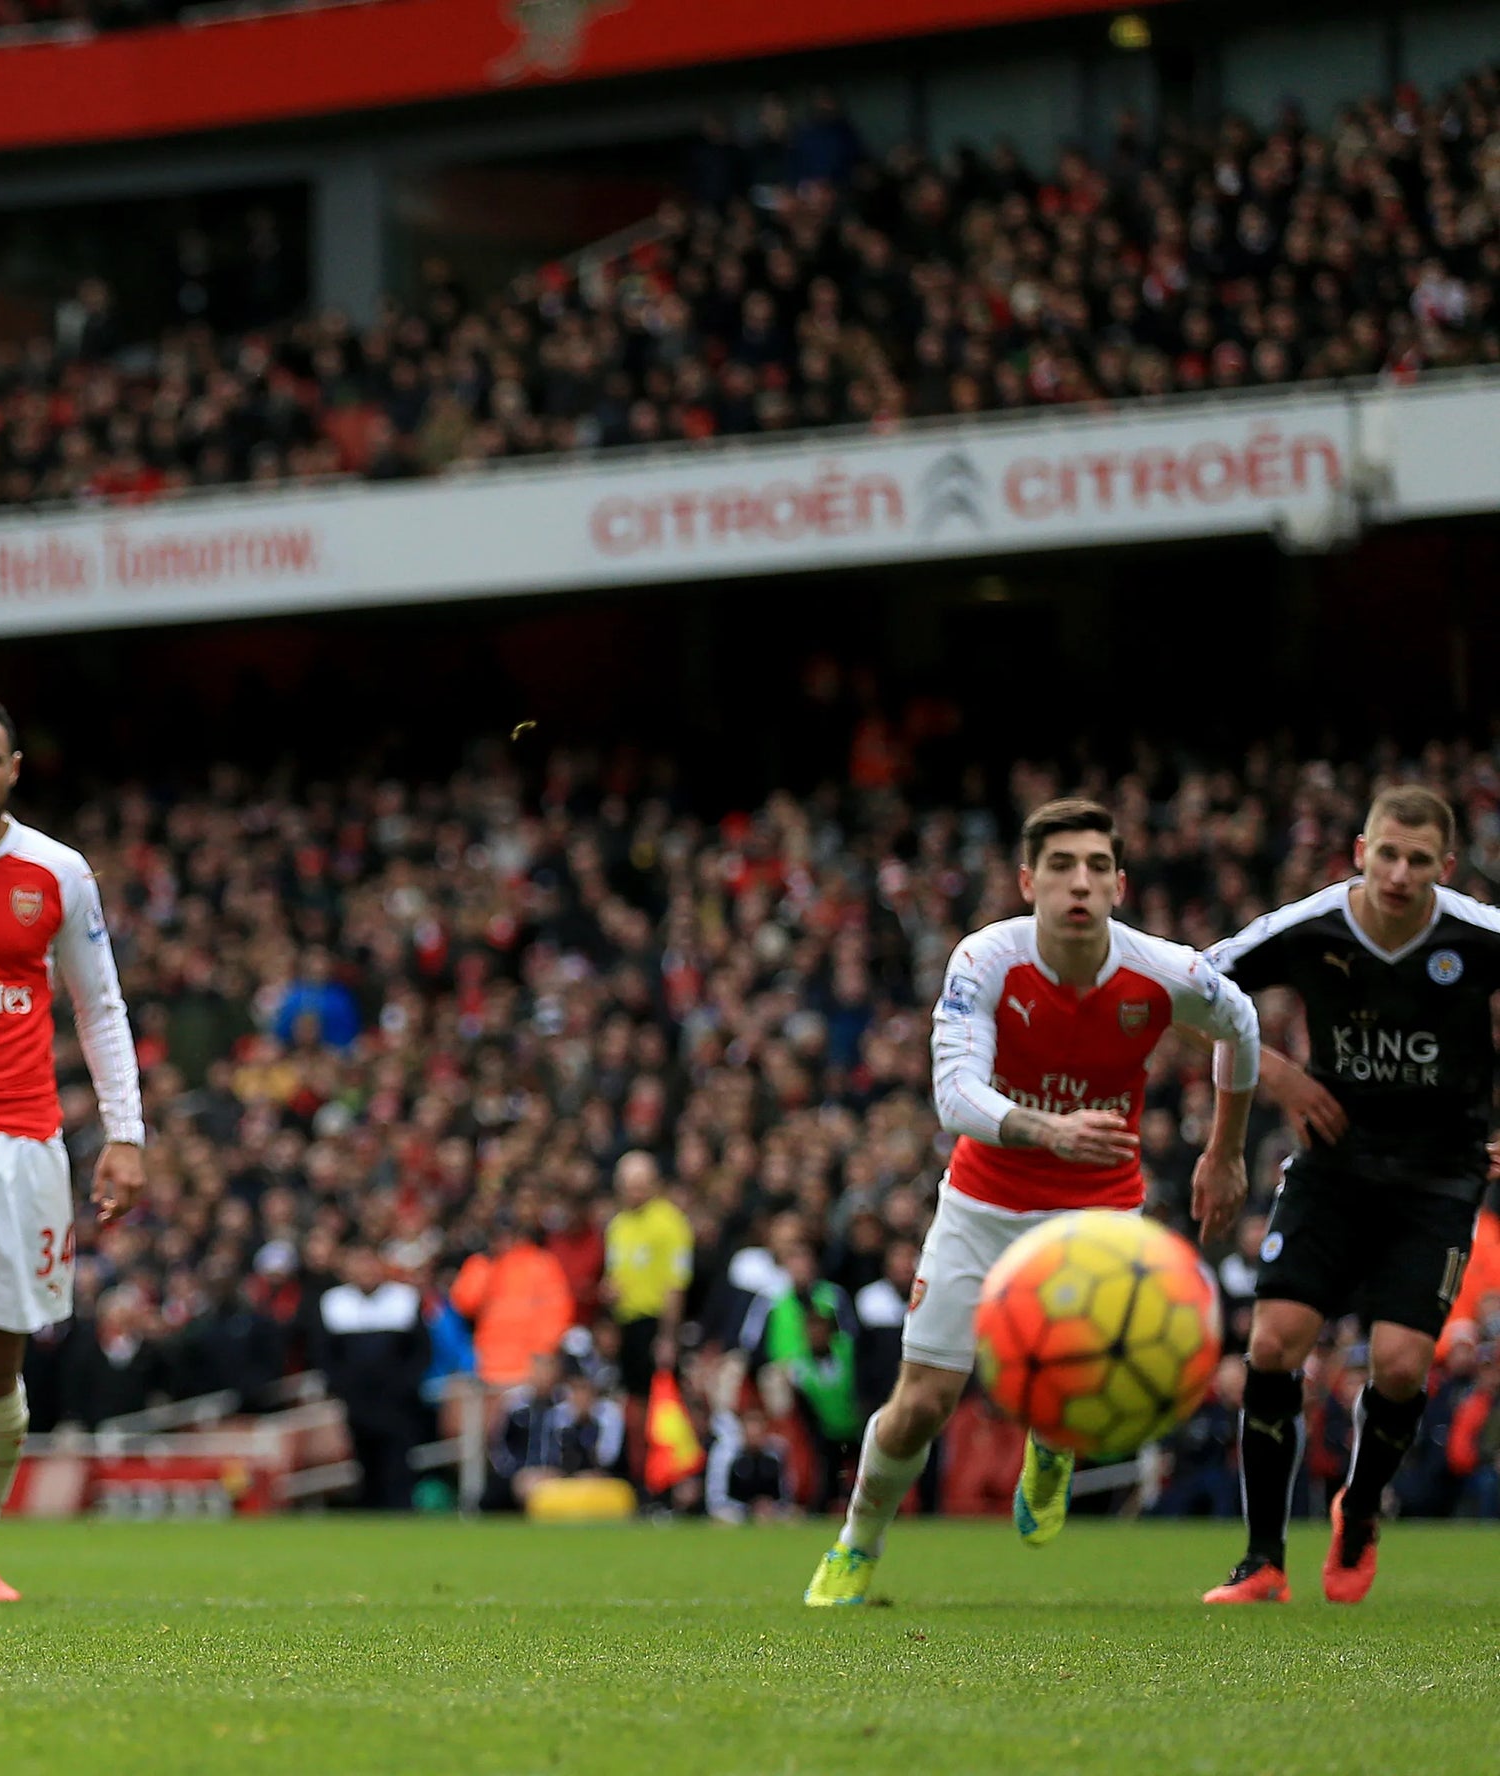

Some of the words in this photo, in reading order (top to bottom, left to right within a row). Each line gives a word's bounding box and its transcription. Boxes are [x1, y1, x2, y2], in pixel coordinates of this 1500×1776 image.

[1332, 1025, 1439, 1064] KING
[1334, 1054, 1439, 1087] POWER
[1041, 1073, 1089, 1103] Fly
